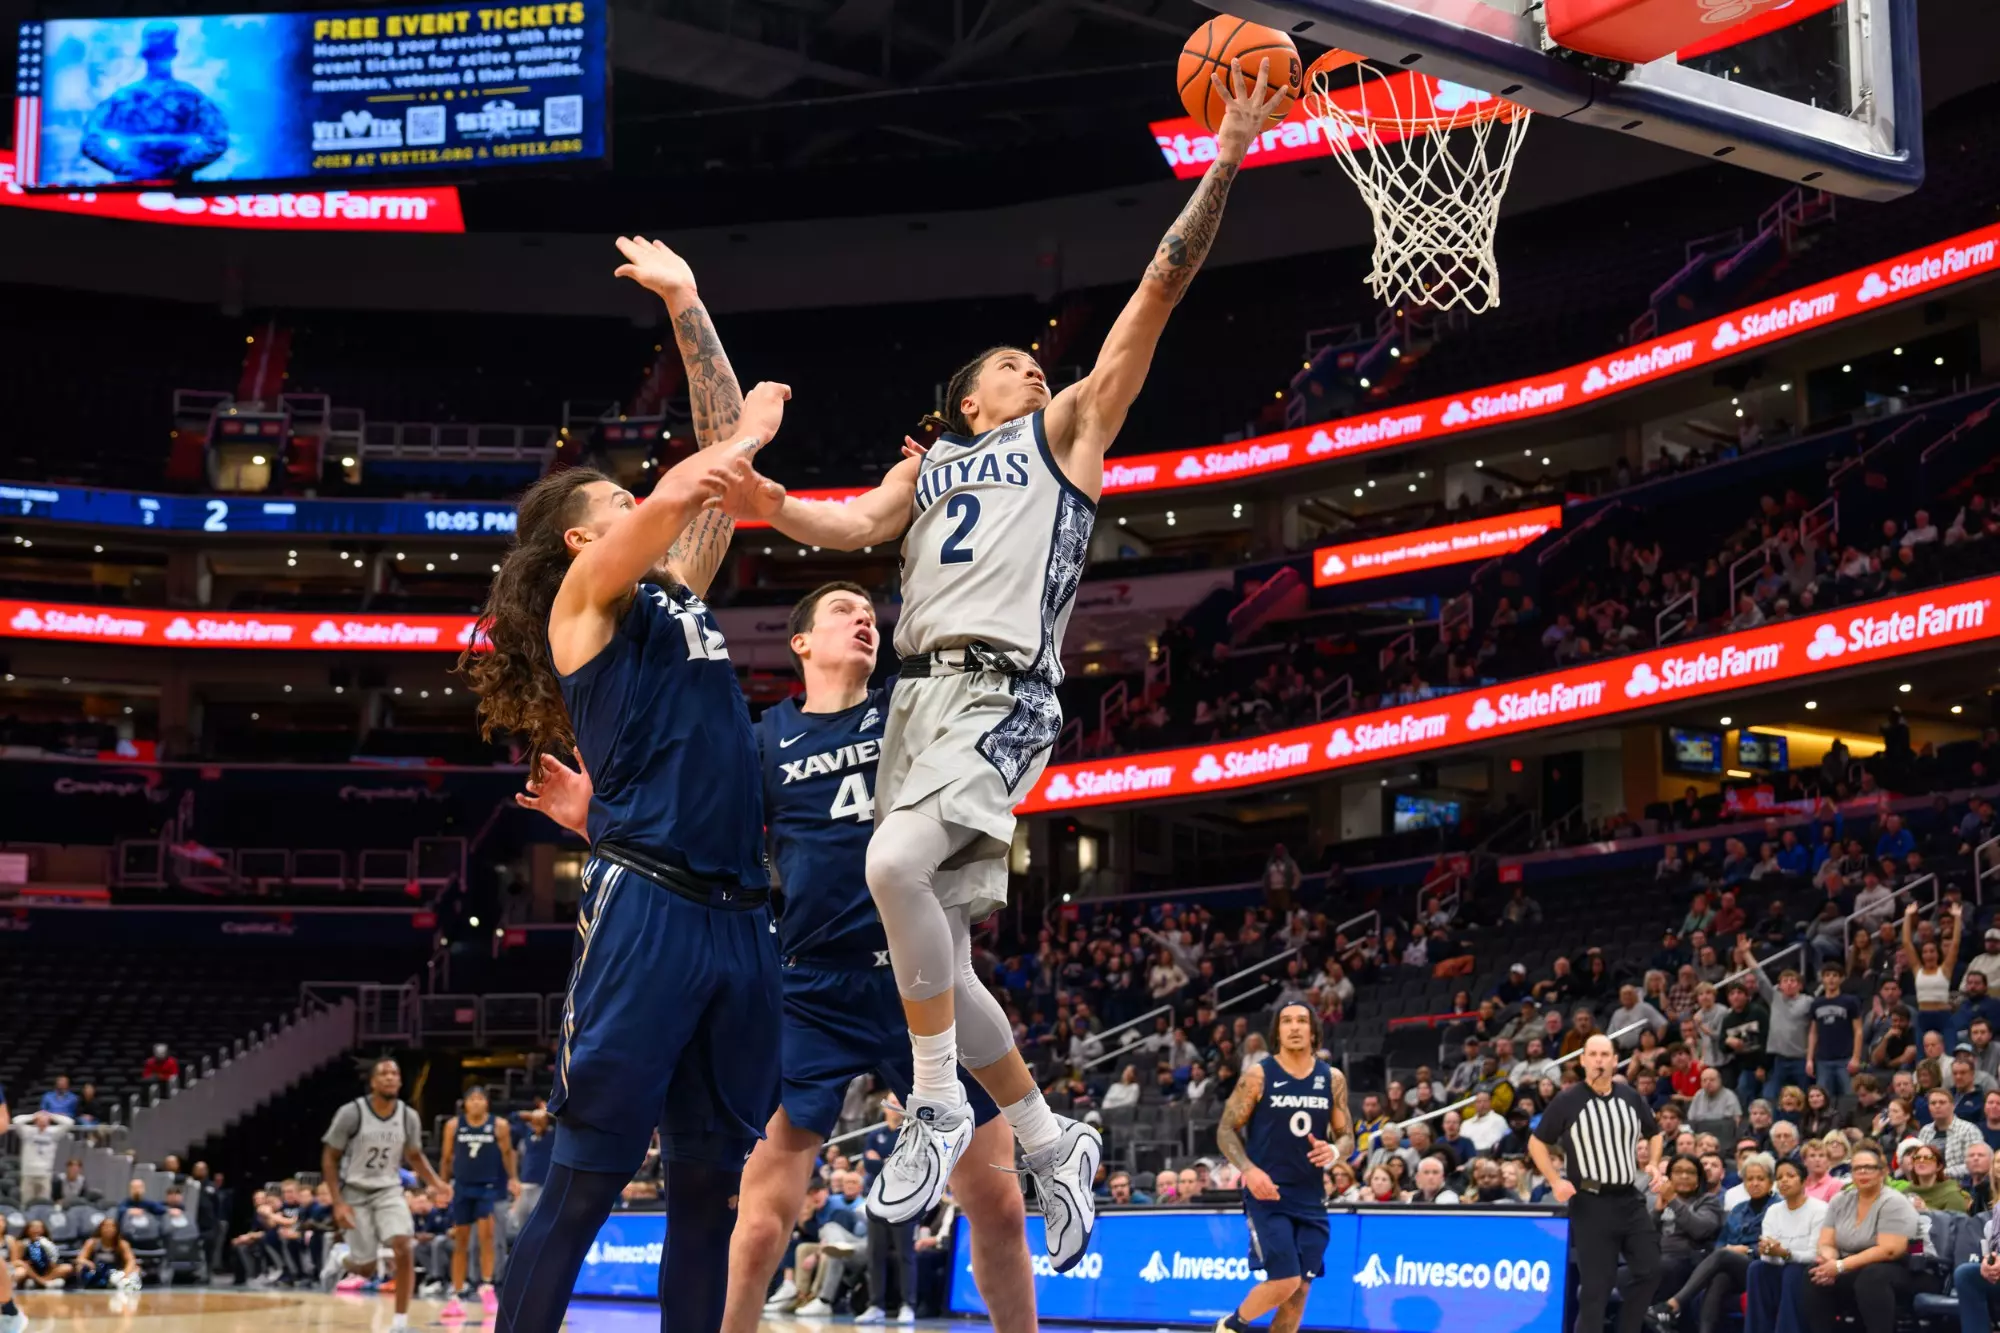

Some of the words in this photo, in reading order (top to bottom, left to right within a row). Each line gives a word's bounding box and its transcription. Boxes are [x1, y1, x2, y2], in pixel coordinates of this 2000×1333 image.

[314, 18, 379, 41] FREE
[386, 11, 470, 37] EVENT
[478, 2, 585, 31] TICKETS
[313, 40, 394, 58] Honoring
[397, 39, 437, 56] your
[440, 33, 502, 50] service
[506, 28, 544, 46] with
[548, 27, 584, 42] free
[312, 60, 361, 75] event
[365, 57, 424, 73] tickets
[428, 54, 454, 69] for
[457, 51, 511, 67] active
[515, 45, 582, 63] military
[393, 72, 460, 88] veterans
[478, 67, 515, 82] their
[915, 452, 1029, 513] HOYAS
[203, 499, 229, 532] 2
[425, 511, 479, 531] 10:05
[483, 511, 518, 531] PM
[940, 493, 982, 565] 2
[779, 738, 884, 785] XAVIE
[830, 771, 875, 823] 4
[1270, 1095, 1329, 1110] XAVIER
[1289, 1110, 1312, 1137] 0
[365, 1147, 391, 1169] 25
[468, 1143, 482, 1158] 7
[1172, 1250, 1250, 1281] Invesco
[1395, 1254, 1491, 1289] Invesco
[1495, 1259, 1551, 1293] QQQ
